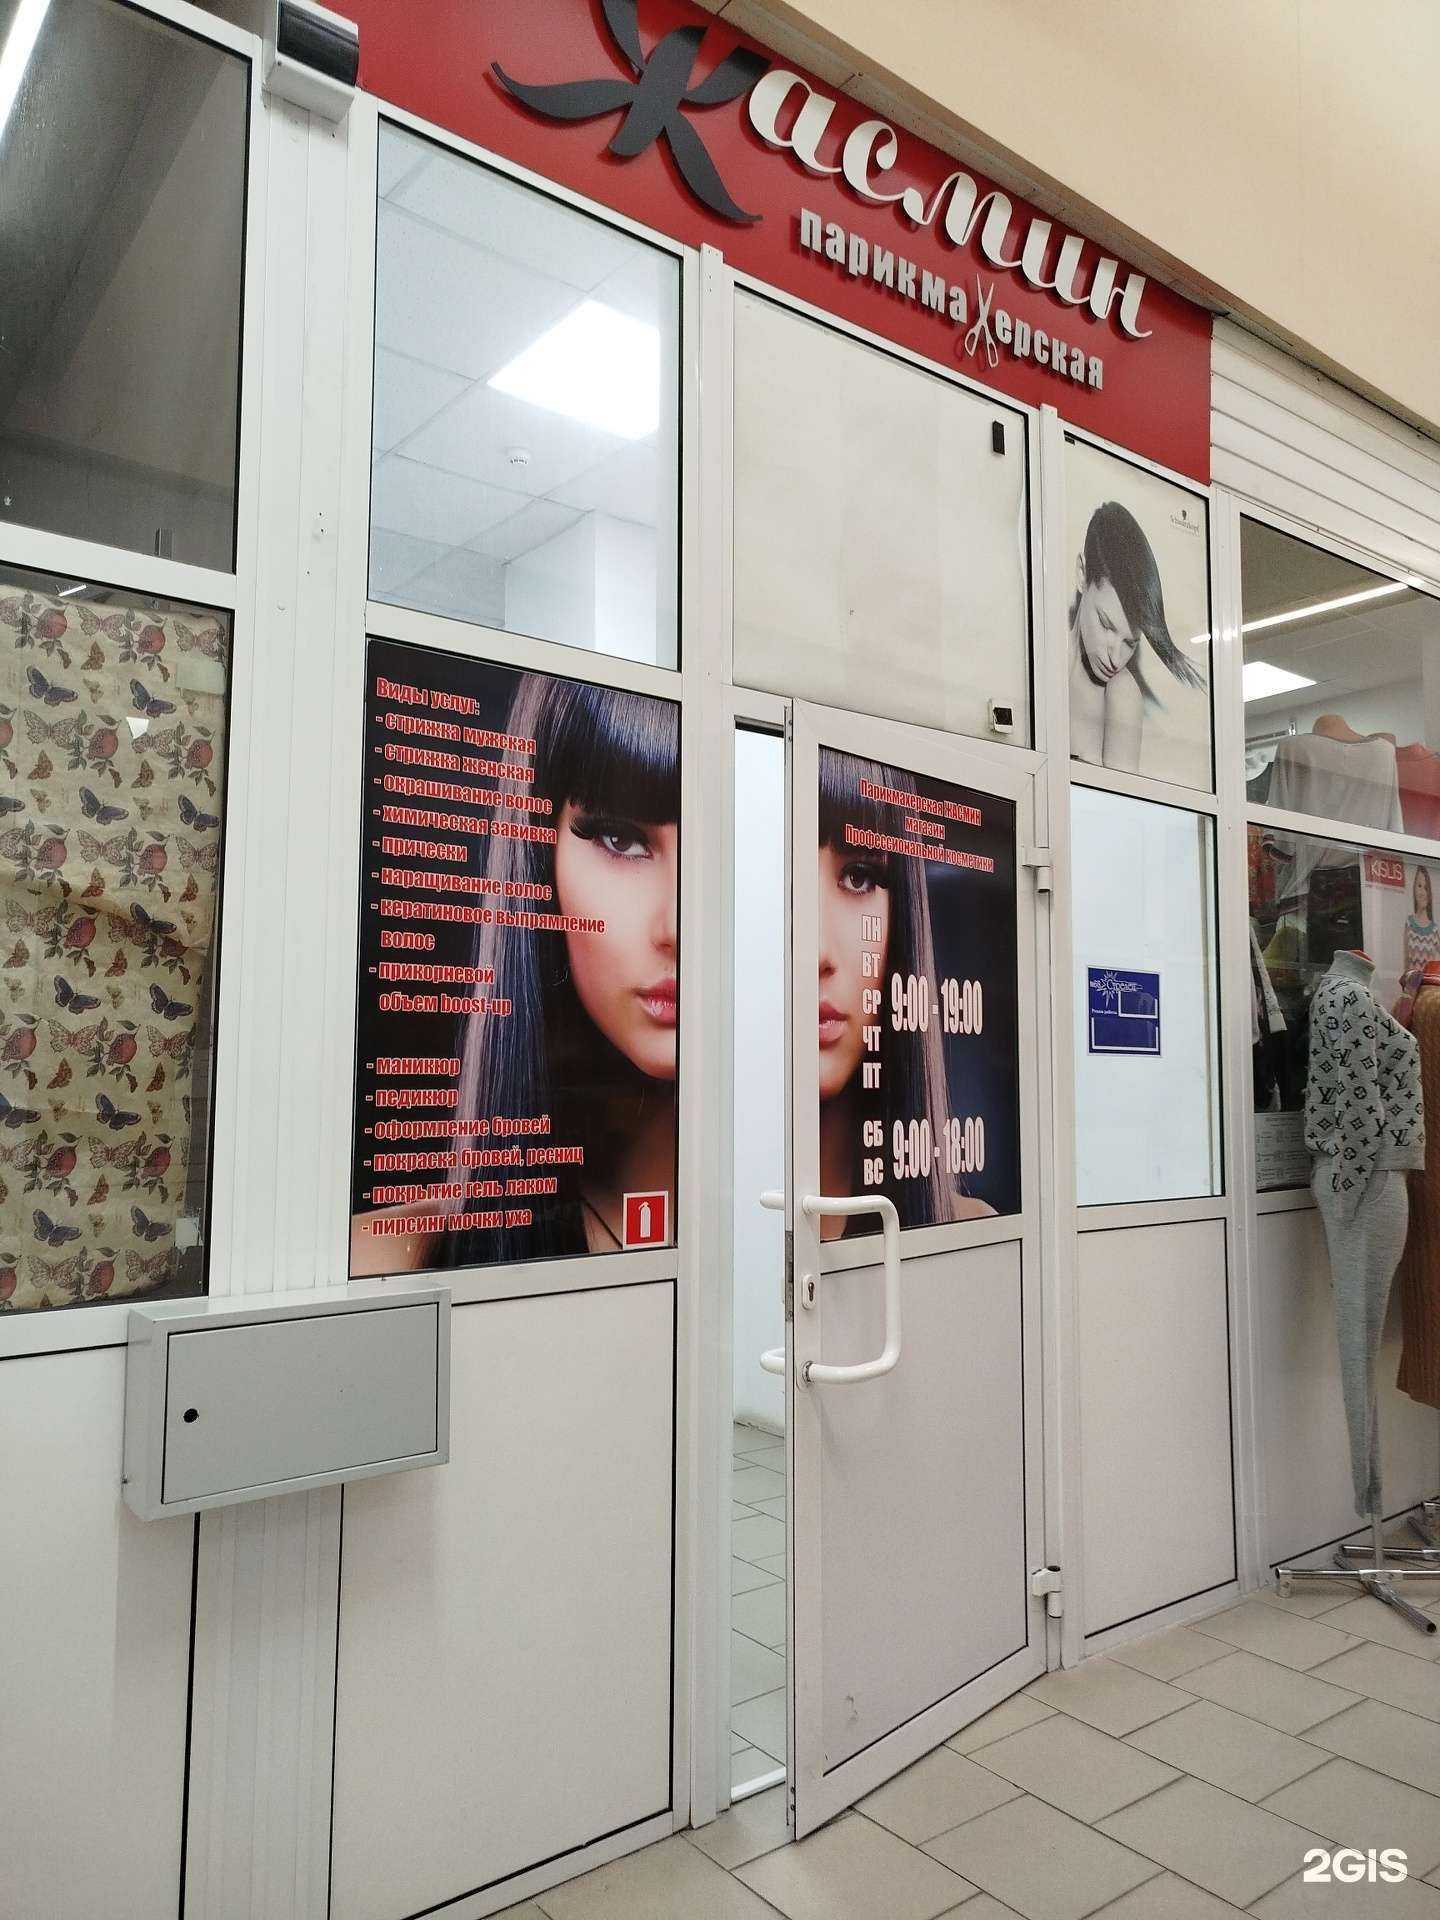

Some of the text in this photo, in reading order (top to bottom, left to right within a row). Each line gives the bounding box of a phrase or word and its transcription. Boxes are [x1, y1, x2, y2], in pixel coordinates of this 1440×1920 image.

[376, 677, 480, 715] Виды услуг:
[386, 713, 460, 741] стрижка
[464, 727, 537, 755] мужская
[384, 744, 460, 771] стрижка
[463, 758, 534, 783] женская
[384, 775, 502, 807] окрашивание
[505, 794, 552, 815] волос
[860, 778, 982, 826] Парикмахерская ЖАСМИН
[383, 805, 488, 834] химическая
[491, 821, 557, 845] завивка
[905, 816, 945, 840] магазин
[382, 837, 467, 862] прически
[846, 824, 994, 873] Профессиональной косметики
[381, 867, 501, 895] наращивание
[505, 878, 552, 900] волос
[380, 899, 492, 924] кератиновое
[496, 910, 605, 934] выпрямление
[862, 914, 882, 942] ПН
[381, 930, 435, 950] волос
[379, 962, 494, 984] прикорневой
[862, 951, 880, 978] ВТ
[379, 992, 512, 1016] объем boost-up
[862, 988, 881, 1015] СР
[891, 972, 928, 1033] 9:00
[940, 978, 983, 1035] 19:00
[862, 1026, 882, 1052] ЧТ
[376, 1058, 460, 1077] маникюр
[862, 1062, 882, 1089] ПТ
[376, 1089, 459, 1108] педикюр
[375, 1118, 489, 1140] оформление
[492, 1115, 551, 1135] бровей
[863, 1120, 883, 1148] СБ
[374, 1151, 457, 1172] покраска
[461, 1146, 524, 1169] бровей,
[527, 1147, 584, 1165] ресниц
[892, 1119, 930, 1180] 9:00
[943, 1116, 984, 1174] 18:00
[864, 1158, 884, 1186] ВС
[372, 1183, 462, 1204] покрытие
[465, 1180, 502, 1198] гель
[505, 1178, 557, 1196] лаком
[371, 1215, 446, 1237] пирсинг
[448, 1211, 502, 1230] мочки
[505, 1209, 532, 1228] уха
